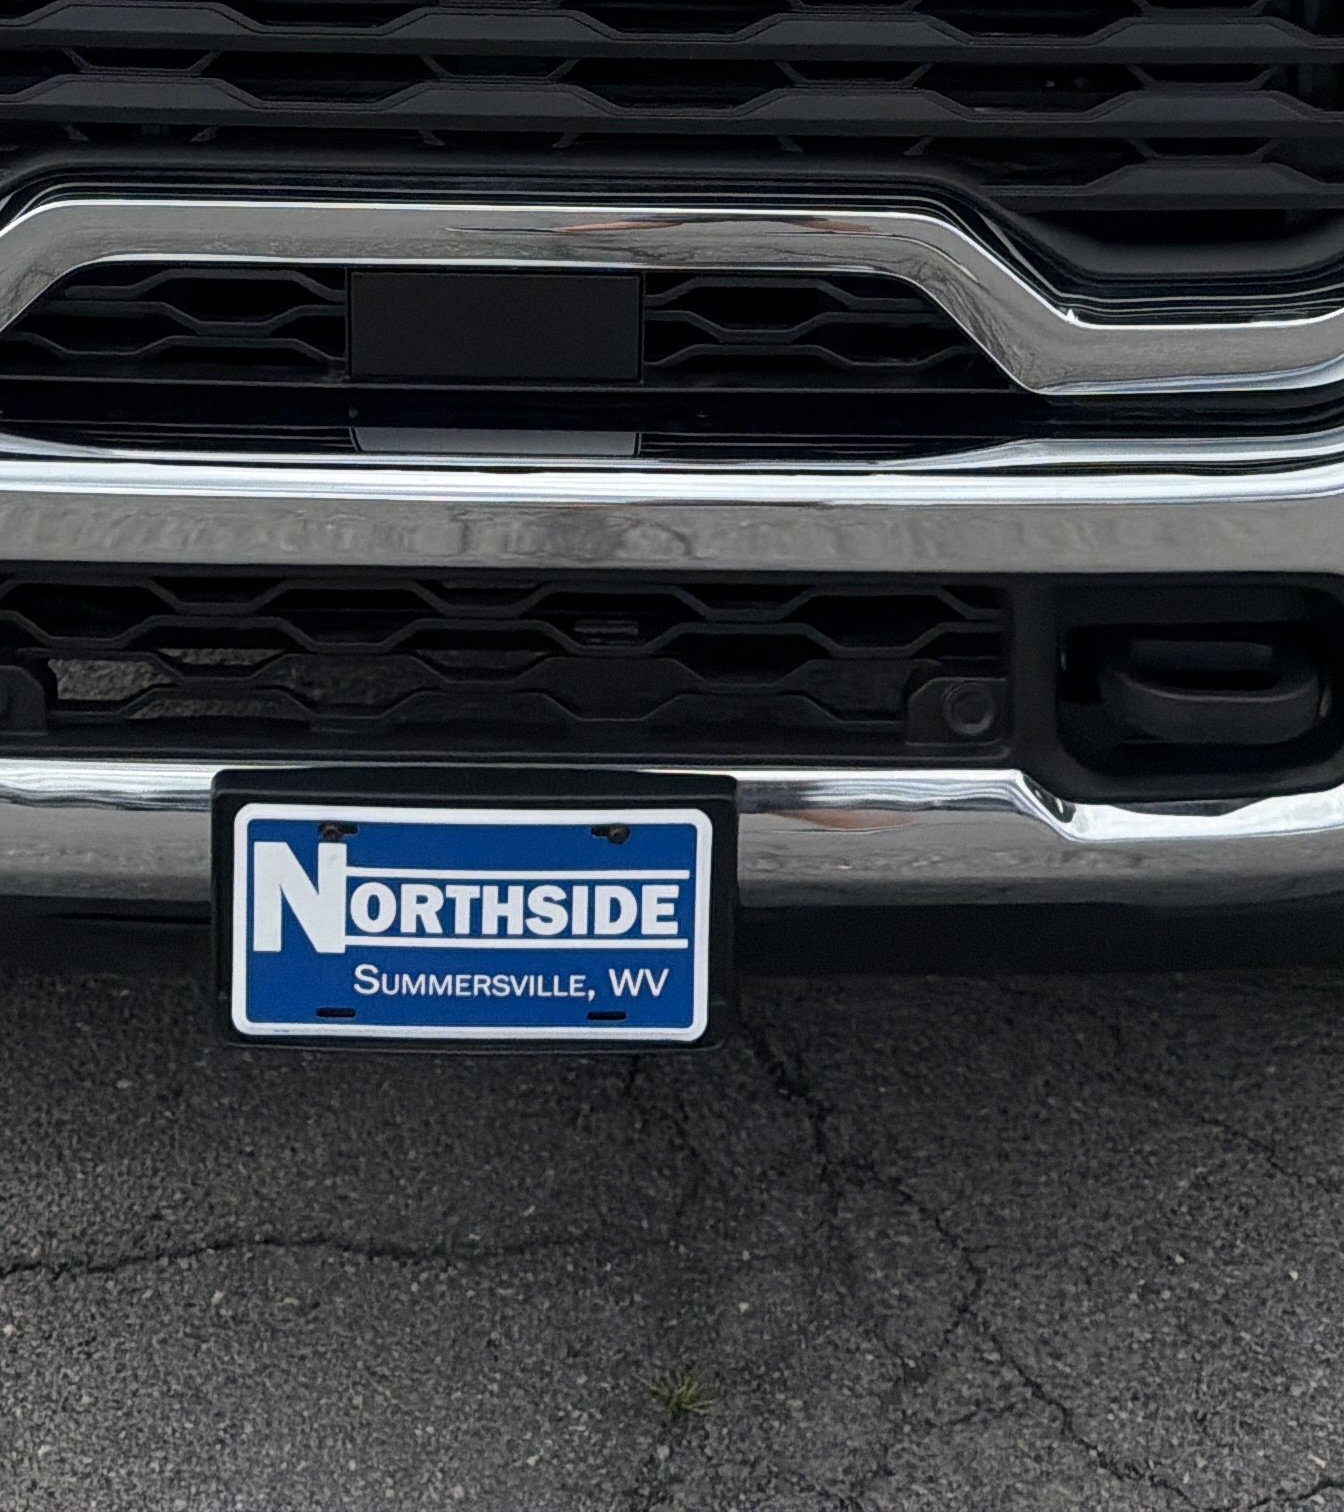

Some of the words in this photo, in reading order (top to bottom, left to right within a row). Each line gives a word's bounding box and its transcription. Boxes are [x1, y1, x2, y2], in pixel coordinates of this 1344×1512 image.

[253, 841, 679, 954] NORTHSIDE
[354, 964, 595, 1001] SUMMERSVILLE,
[609, 968, 669, 997] WV
